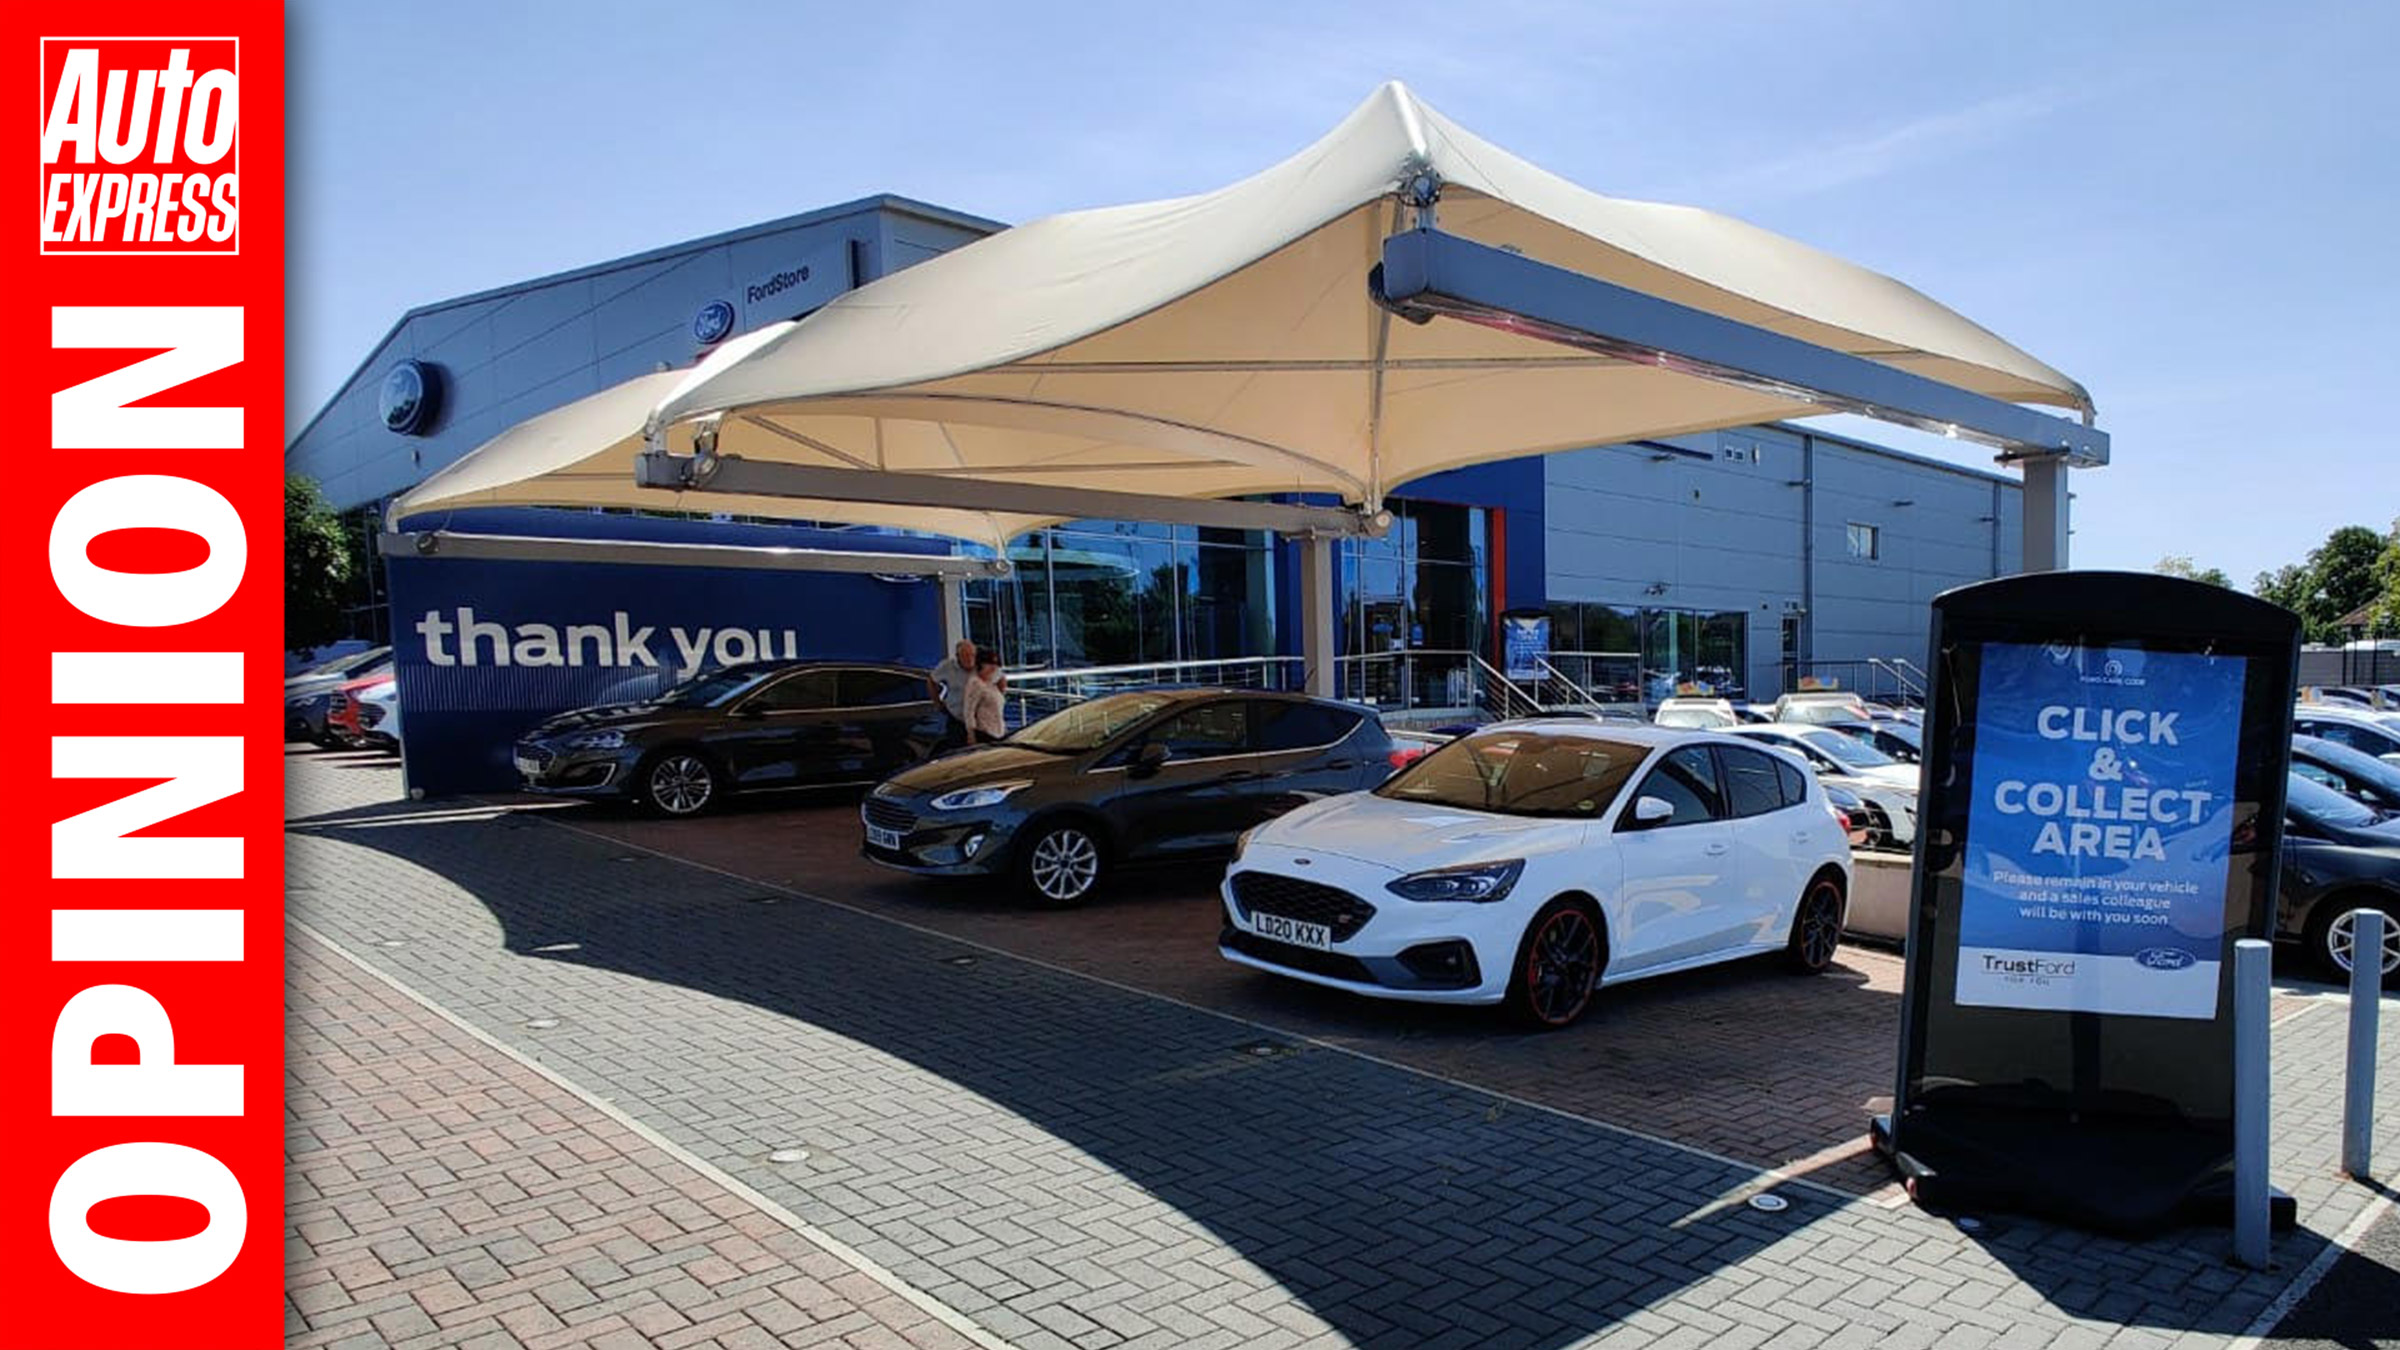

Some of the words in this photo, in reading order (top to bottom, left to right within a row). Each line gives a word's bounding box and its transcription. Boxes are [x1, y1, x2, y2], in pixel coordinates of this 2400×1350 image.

[747, 265, 810, 303] FordStore
[416, 607, 660, 667] thank
[670, 626, 798, 680] you
[2037, 706, 2180, 746] CLICK
[2088, 747, 2122, 781] &
[1994, 780, 2212, 825] COLLECT
[2031, 821, 2167, 862] AREA
[1993, 871, 2043, 887] Please
[2044, 874, 2096, 889] remain
[2097, 876, 2112, 890] in
[2113, 881, 2147, 894] your
[2148, 880, 2200, 895] vehicle
[2020, 890, 2048, 903] and
[2050, 894, 2059, 903] a
[2061, 892, 2099, 906] sales
[2101, 894, 2172, 911] colleague
[2020, 906, 2046, 919] will
[2048, 908, 2067, 920] be
[2070, 908, 2101, 922] with
[2104, 913, 2131, 925] you
[2133, 914, 2168, 926] soon
[1256, 914, 1292, 939] LD20
[1295, 922, 1325, 947] KXX
[1982, 955, 2076, 975] TrustFord
[2145, 949, 2186, 969] Ford
